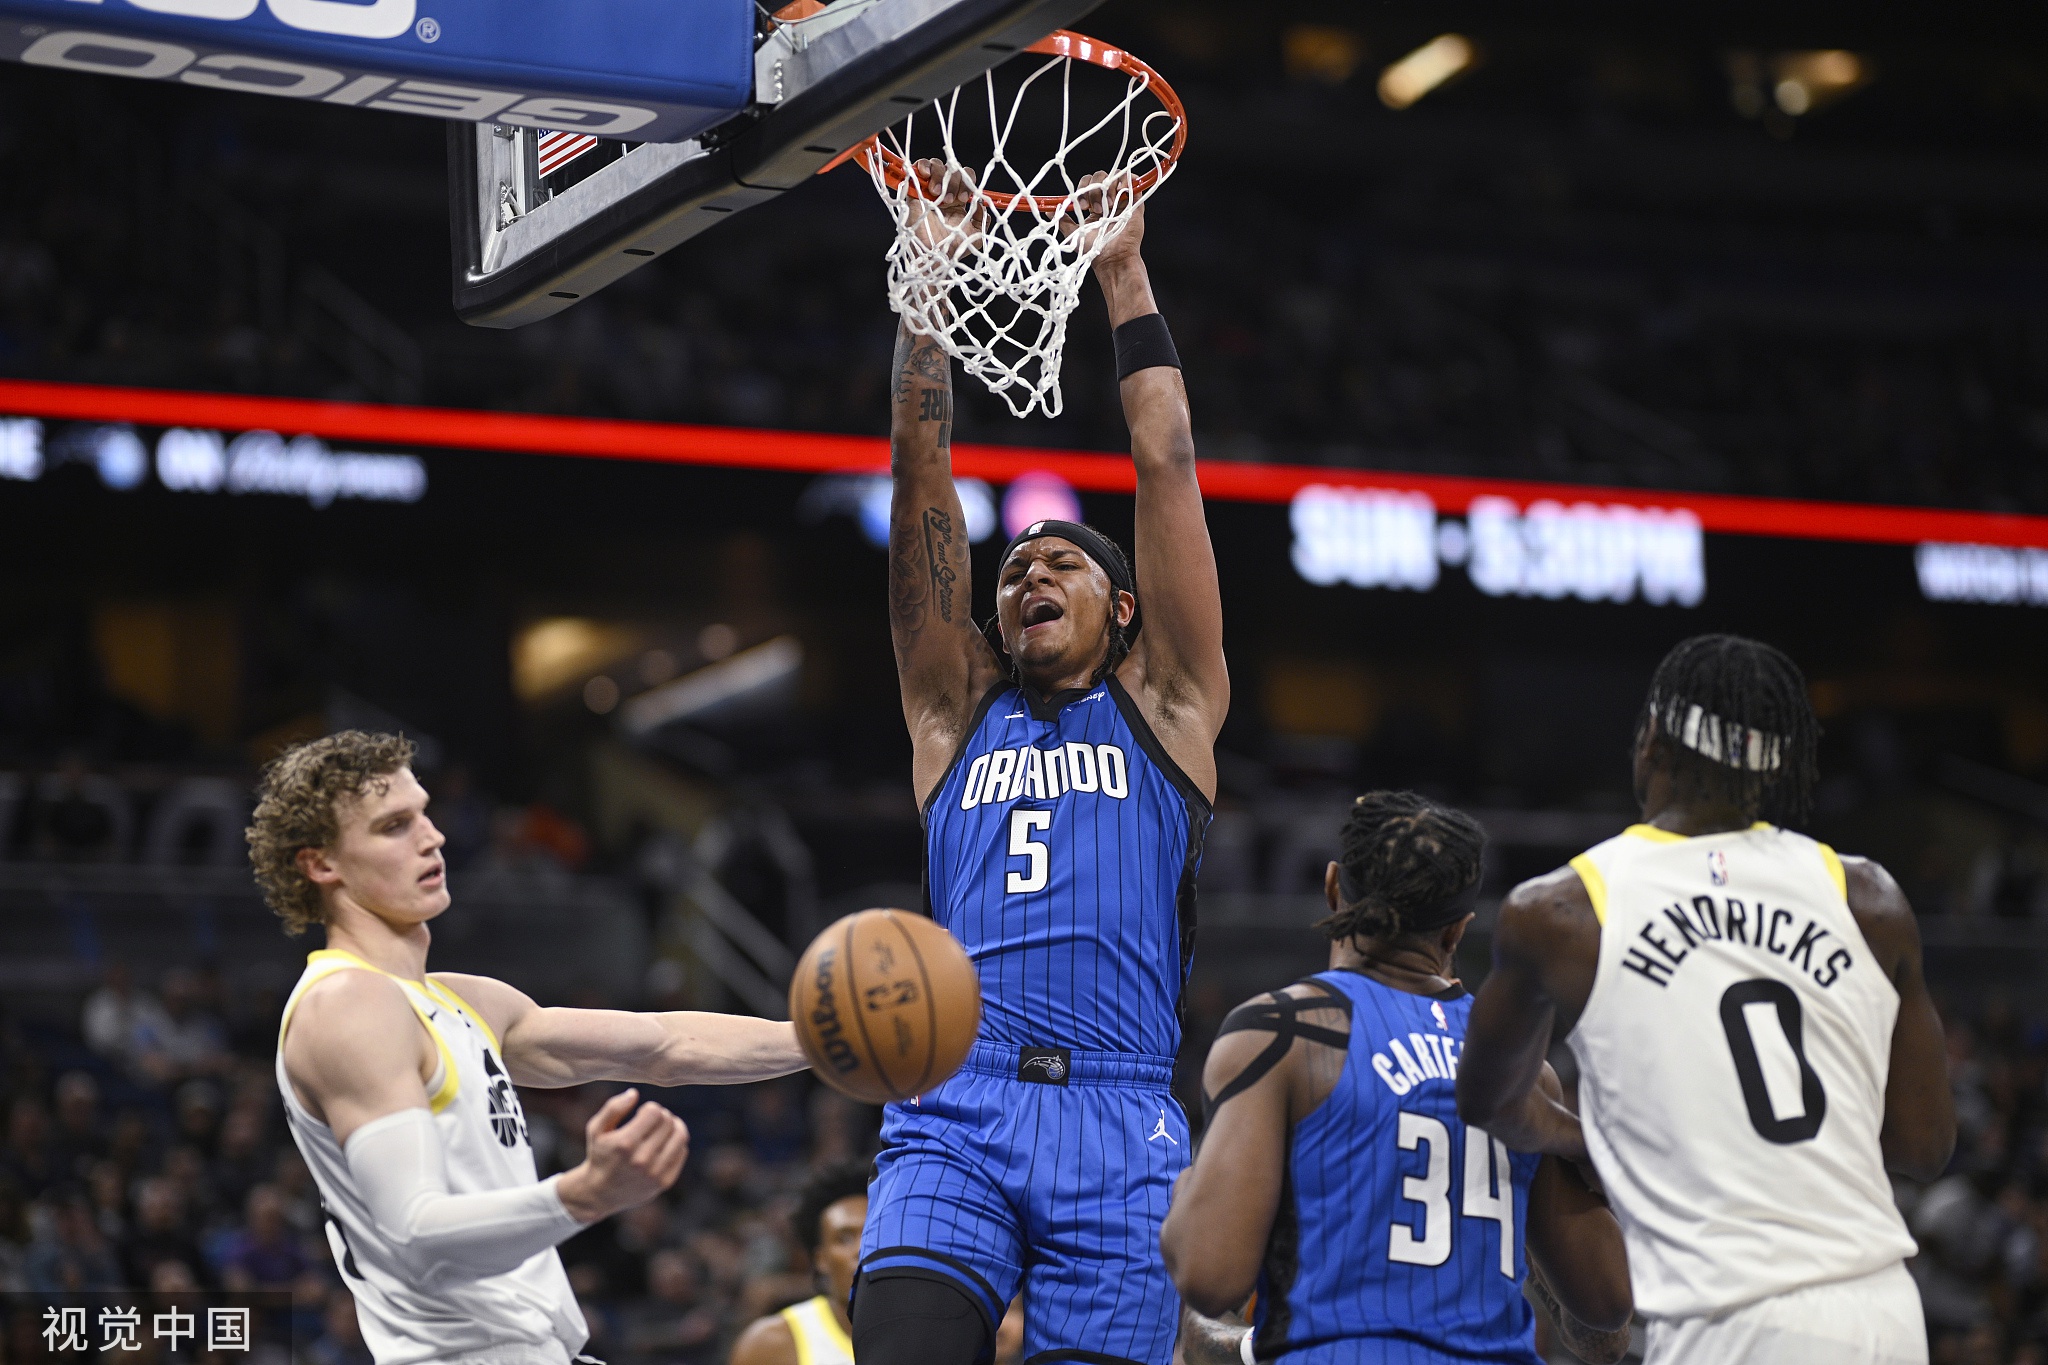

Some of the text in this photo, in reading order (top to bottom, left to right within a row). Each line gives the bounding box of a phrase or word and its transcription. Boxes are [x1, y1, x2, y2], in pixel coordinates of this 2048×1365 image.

[20, 31, 657, 134] GEICO
[960, 741, 1129, 811] ORLANDO
[1006, 809, 1051, 894] 5
[1621, 895, 1854, 989] HENDRICKS
[1370, 1032, 1467, 1097] CARTE
[1719, 978, 1828, 1146] 0
[1388, 1111, 1515, 1280] 34
